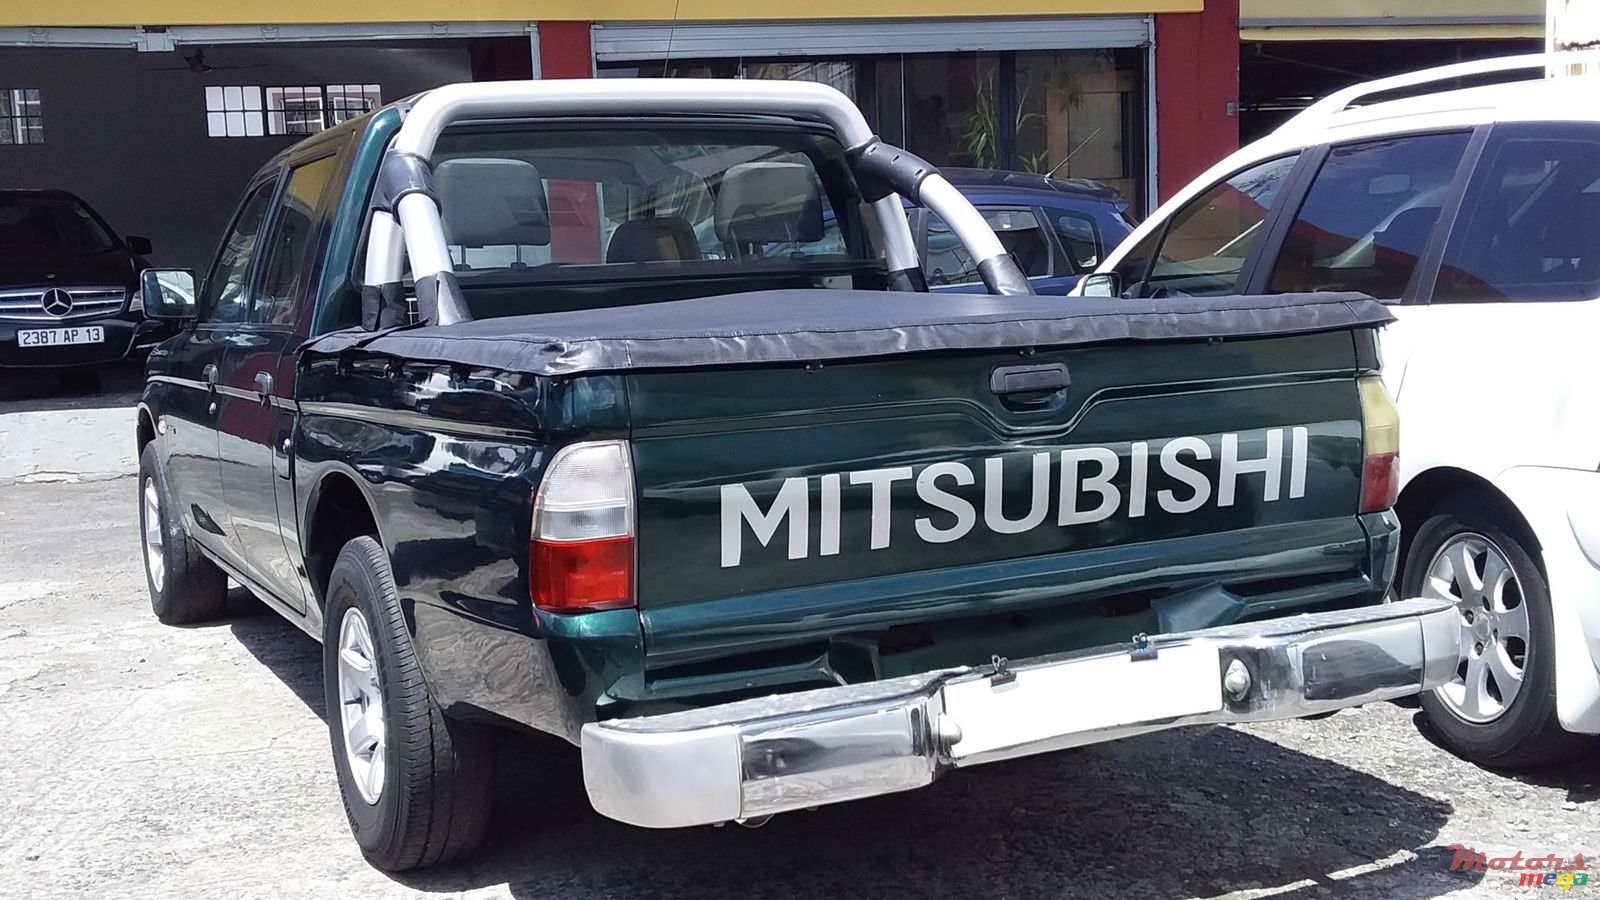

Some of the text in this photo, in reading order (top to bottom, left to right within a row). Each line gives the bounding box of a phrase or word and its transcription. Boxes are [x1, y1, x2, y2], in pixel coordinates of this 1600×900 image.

[22, 328, 101, 345] 2387 AP 13
[720, 426, 1308, 568] MITSUBISHI
